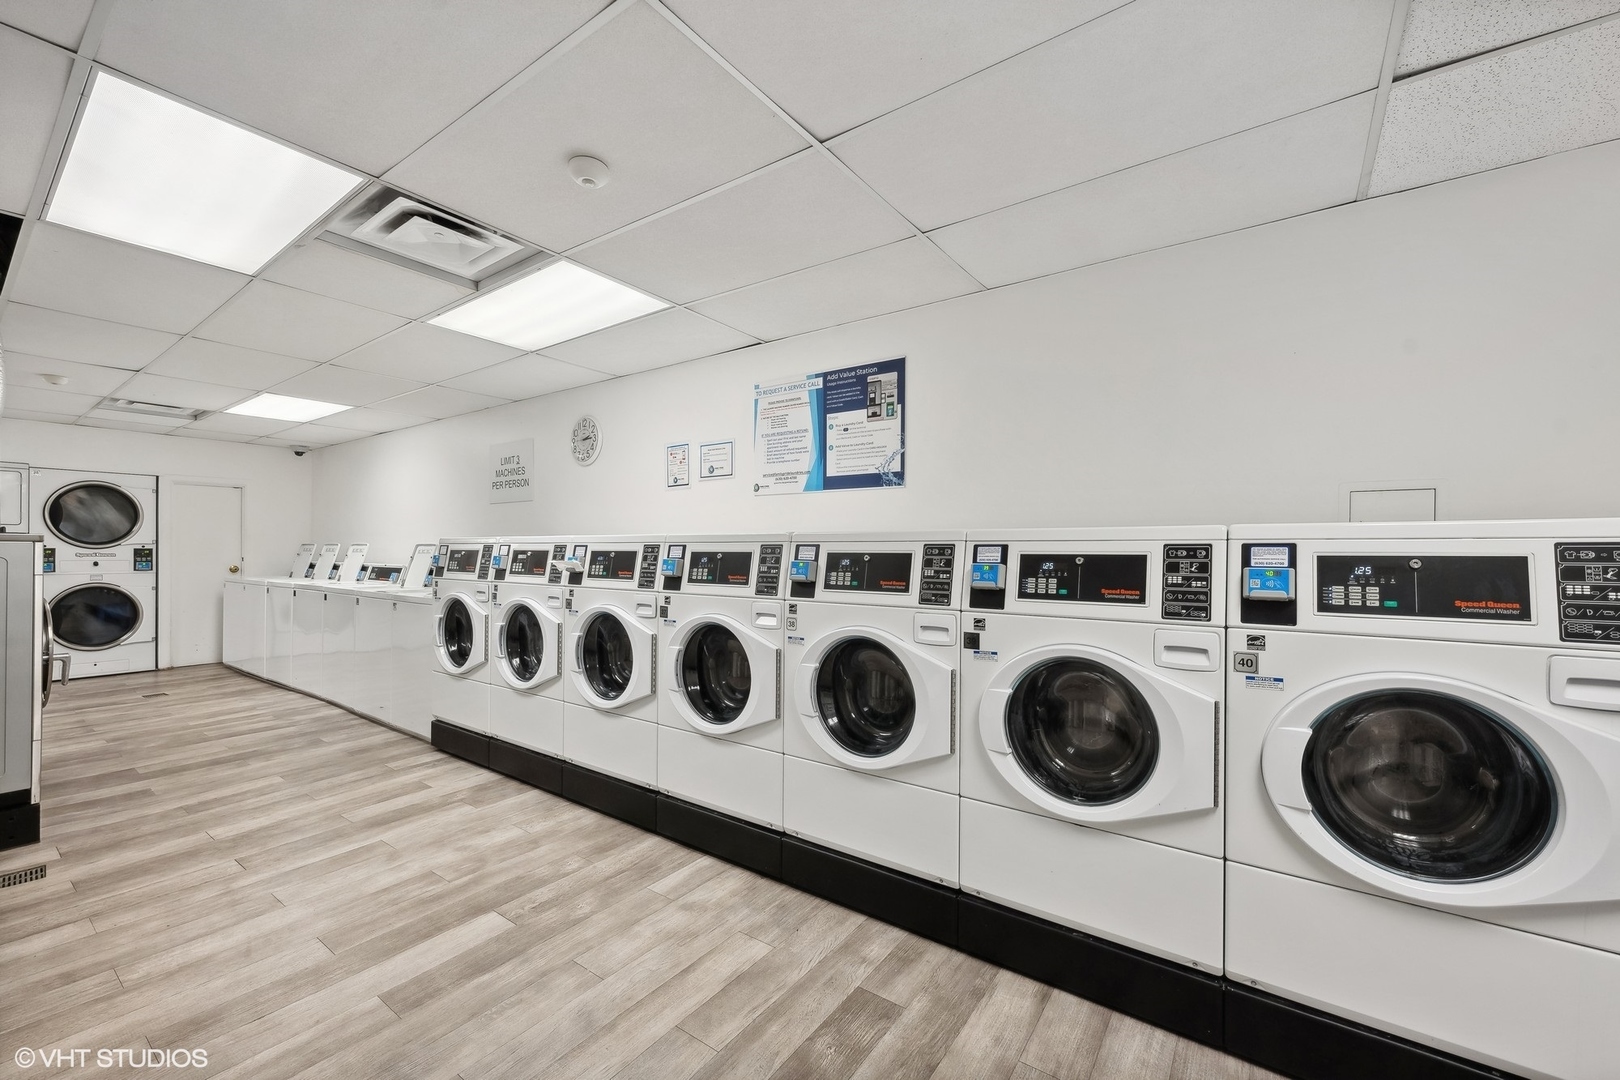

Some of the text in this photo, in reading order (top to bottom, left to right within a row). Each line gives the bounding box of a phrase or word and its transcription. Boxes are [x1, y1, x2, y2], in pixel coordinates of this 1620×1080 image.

[856, 367, 878, 375] Station
[763, 387, 783, 396] REQUEST
[788, 383, 806, 391] SERVICE
[582, 419, 587, 427] 12
[591, 425, 595, 433] 2
[593, 434, 596, 442] 3
[586, 450, 590, 458] 5
[501, 455, 520, 465] LIMIT 3
[496, 466, 525, 477] MACHINES
[492, 478, 529, 489] PER PERSON
[1238, 658, 1253, 668] 40
